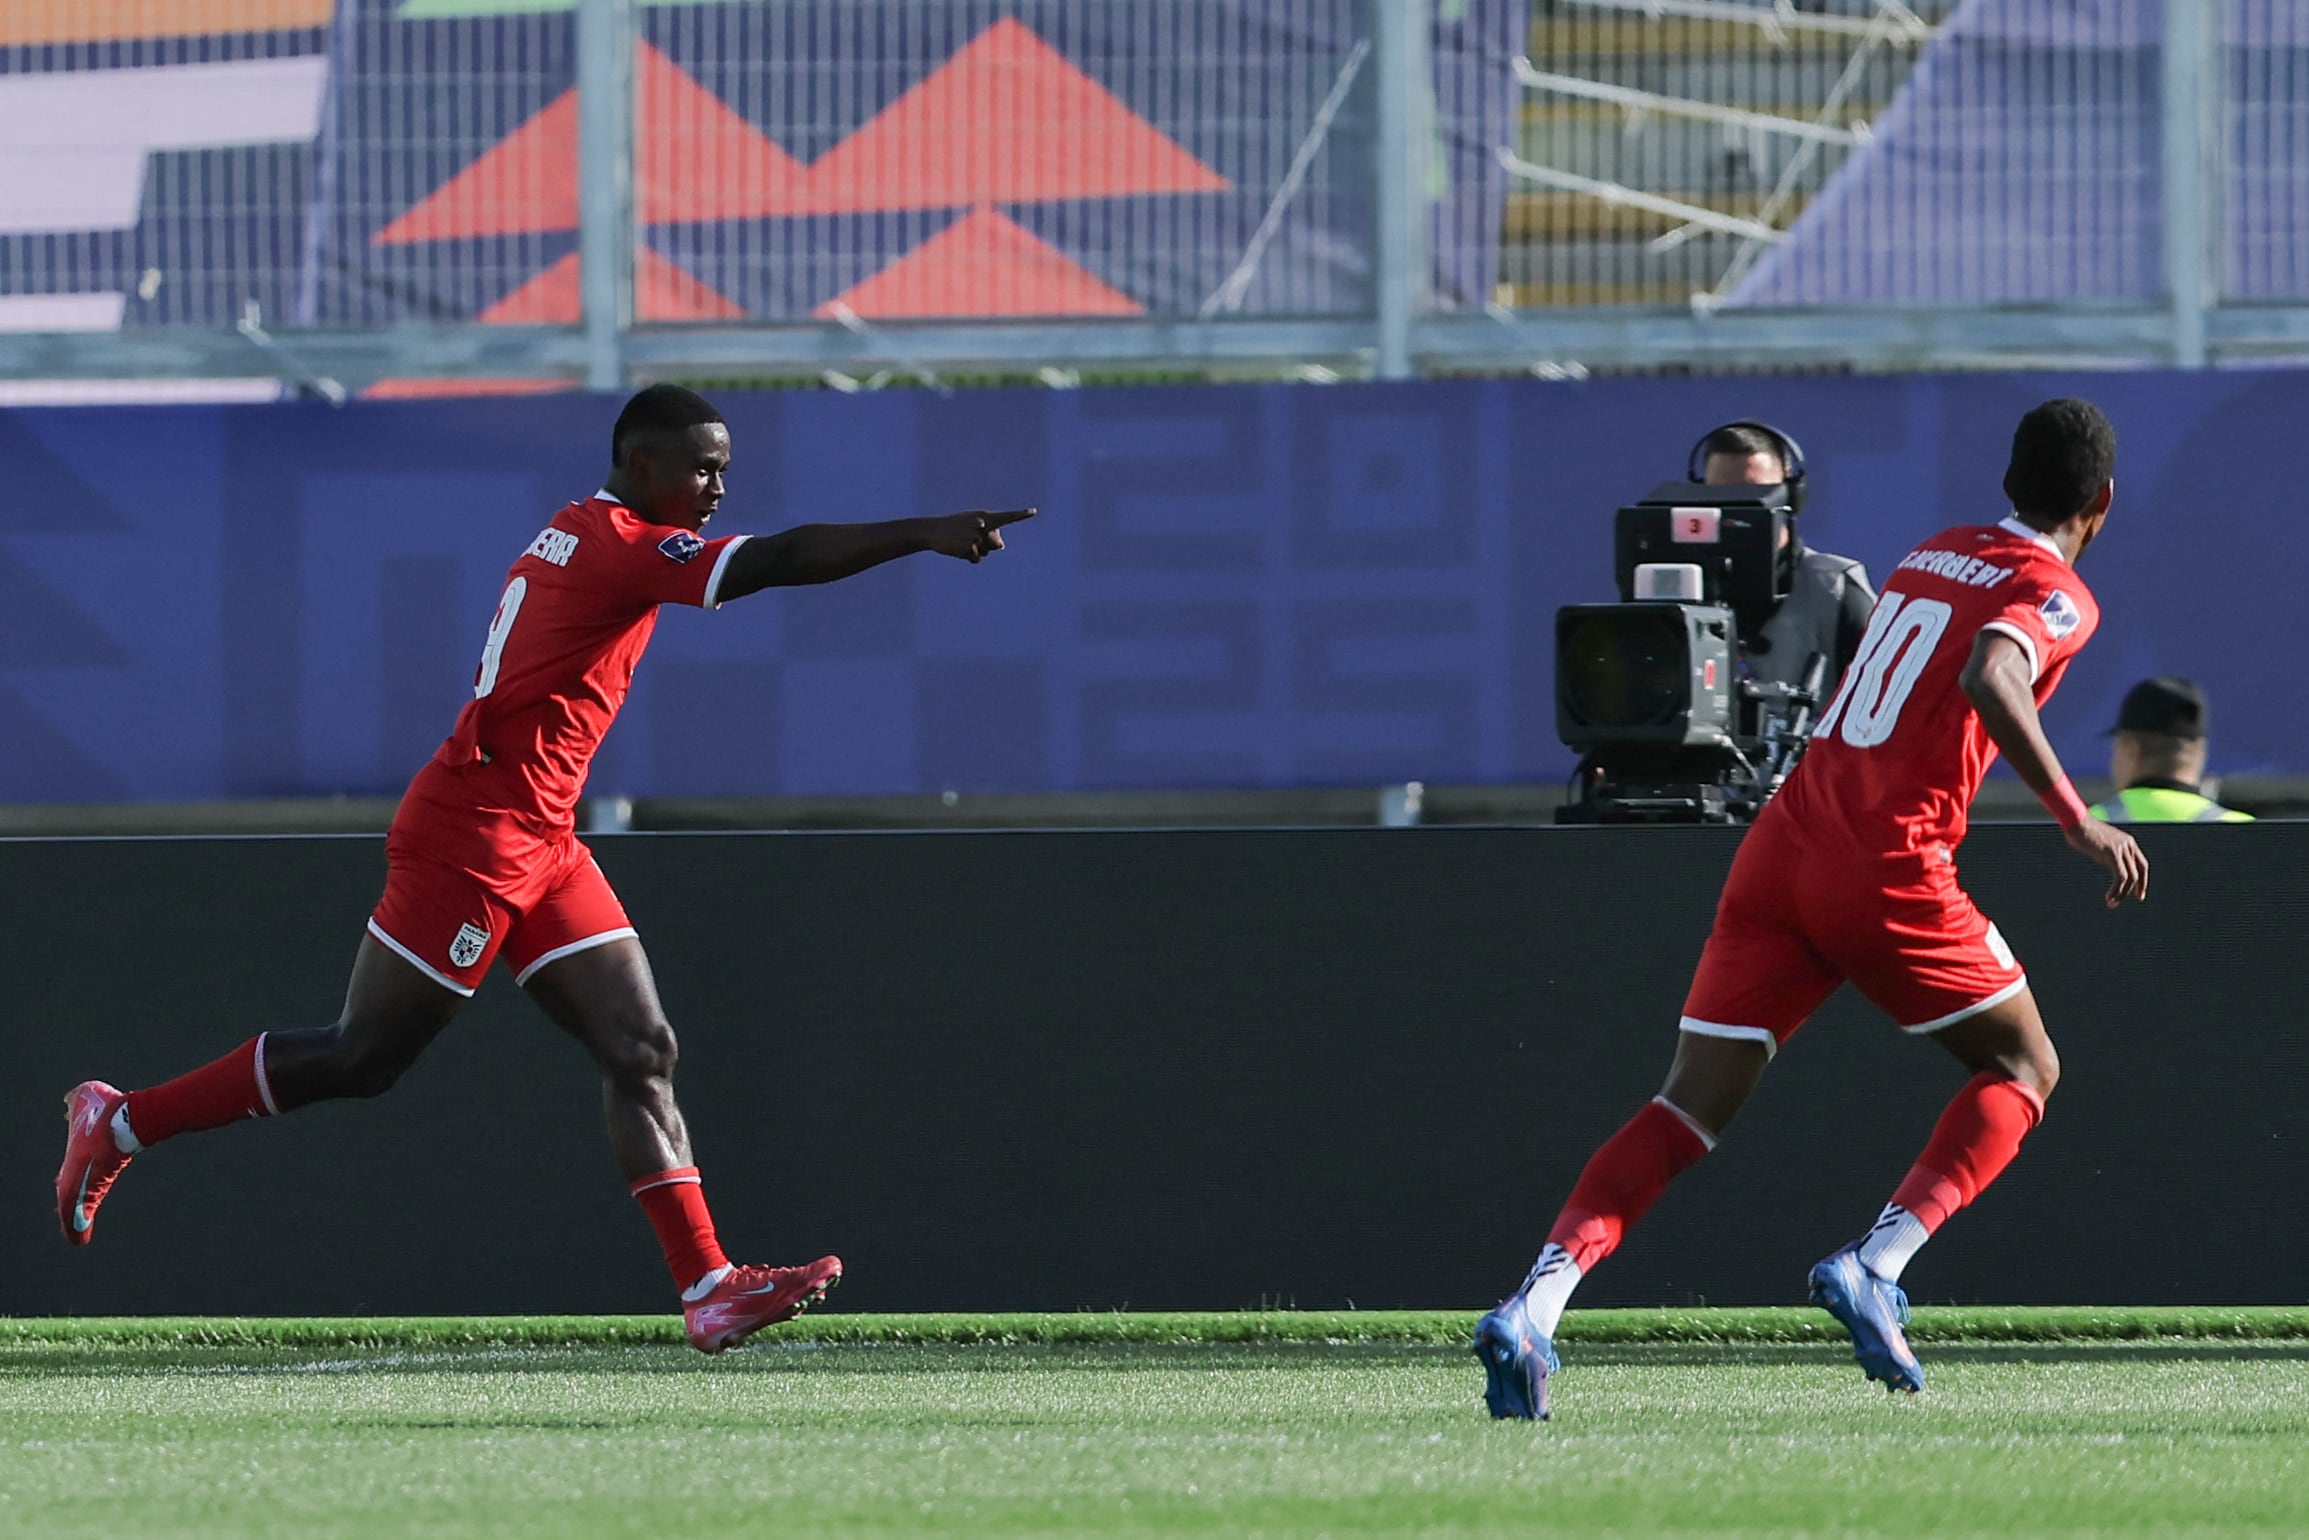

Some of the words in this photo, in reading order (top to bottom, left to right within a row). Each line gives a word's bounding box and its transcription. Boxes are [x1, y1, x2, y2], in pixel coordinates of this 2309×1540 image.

[1689, 518, 1702, 534] 3
[474, 576, 527, 699] 9
[1812, 591, 1952, 748] 10
